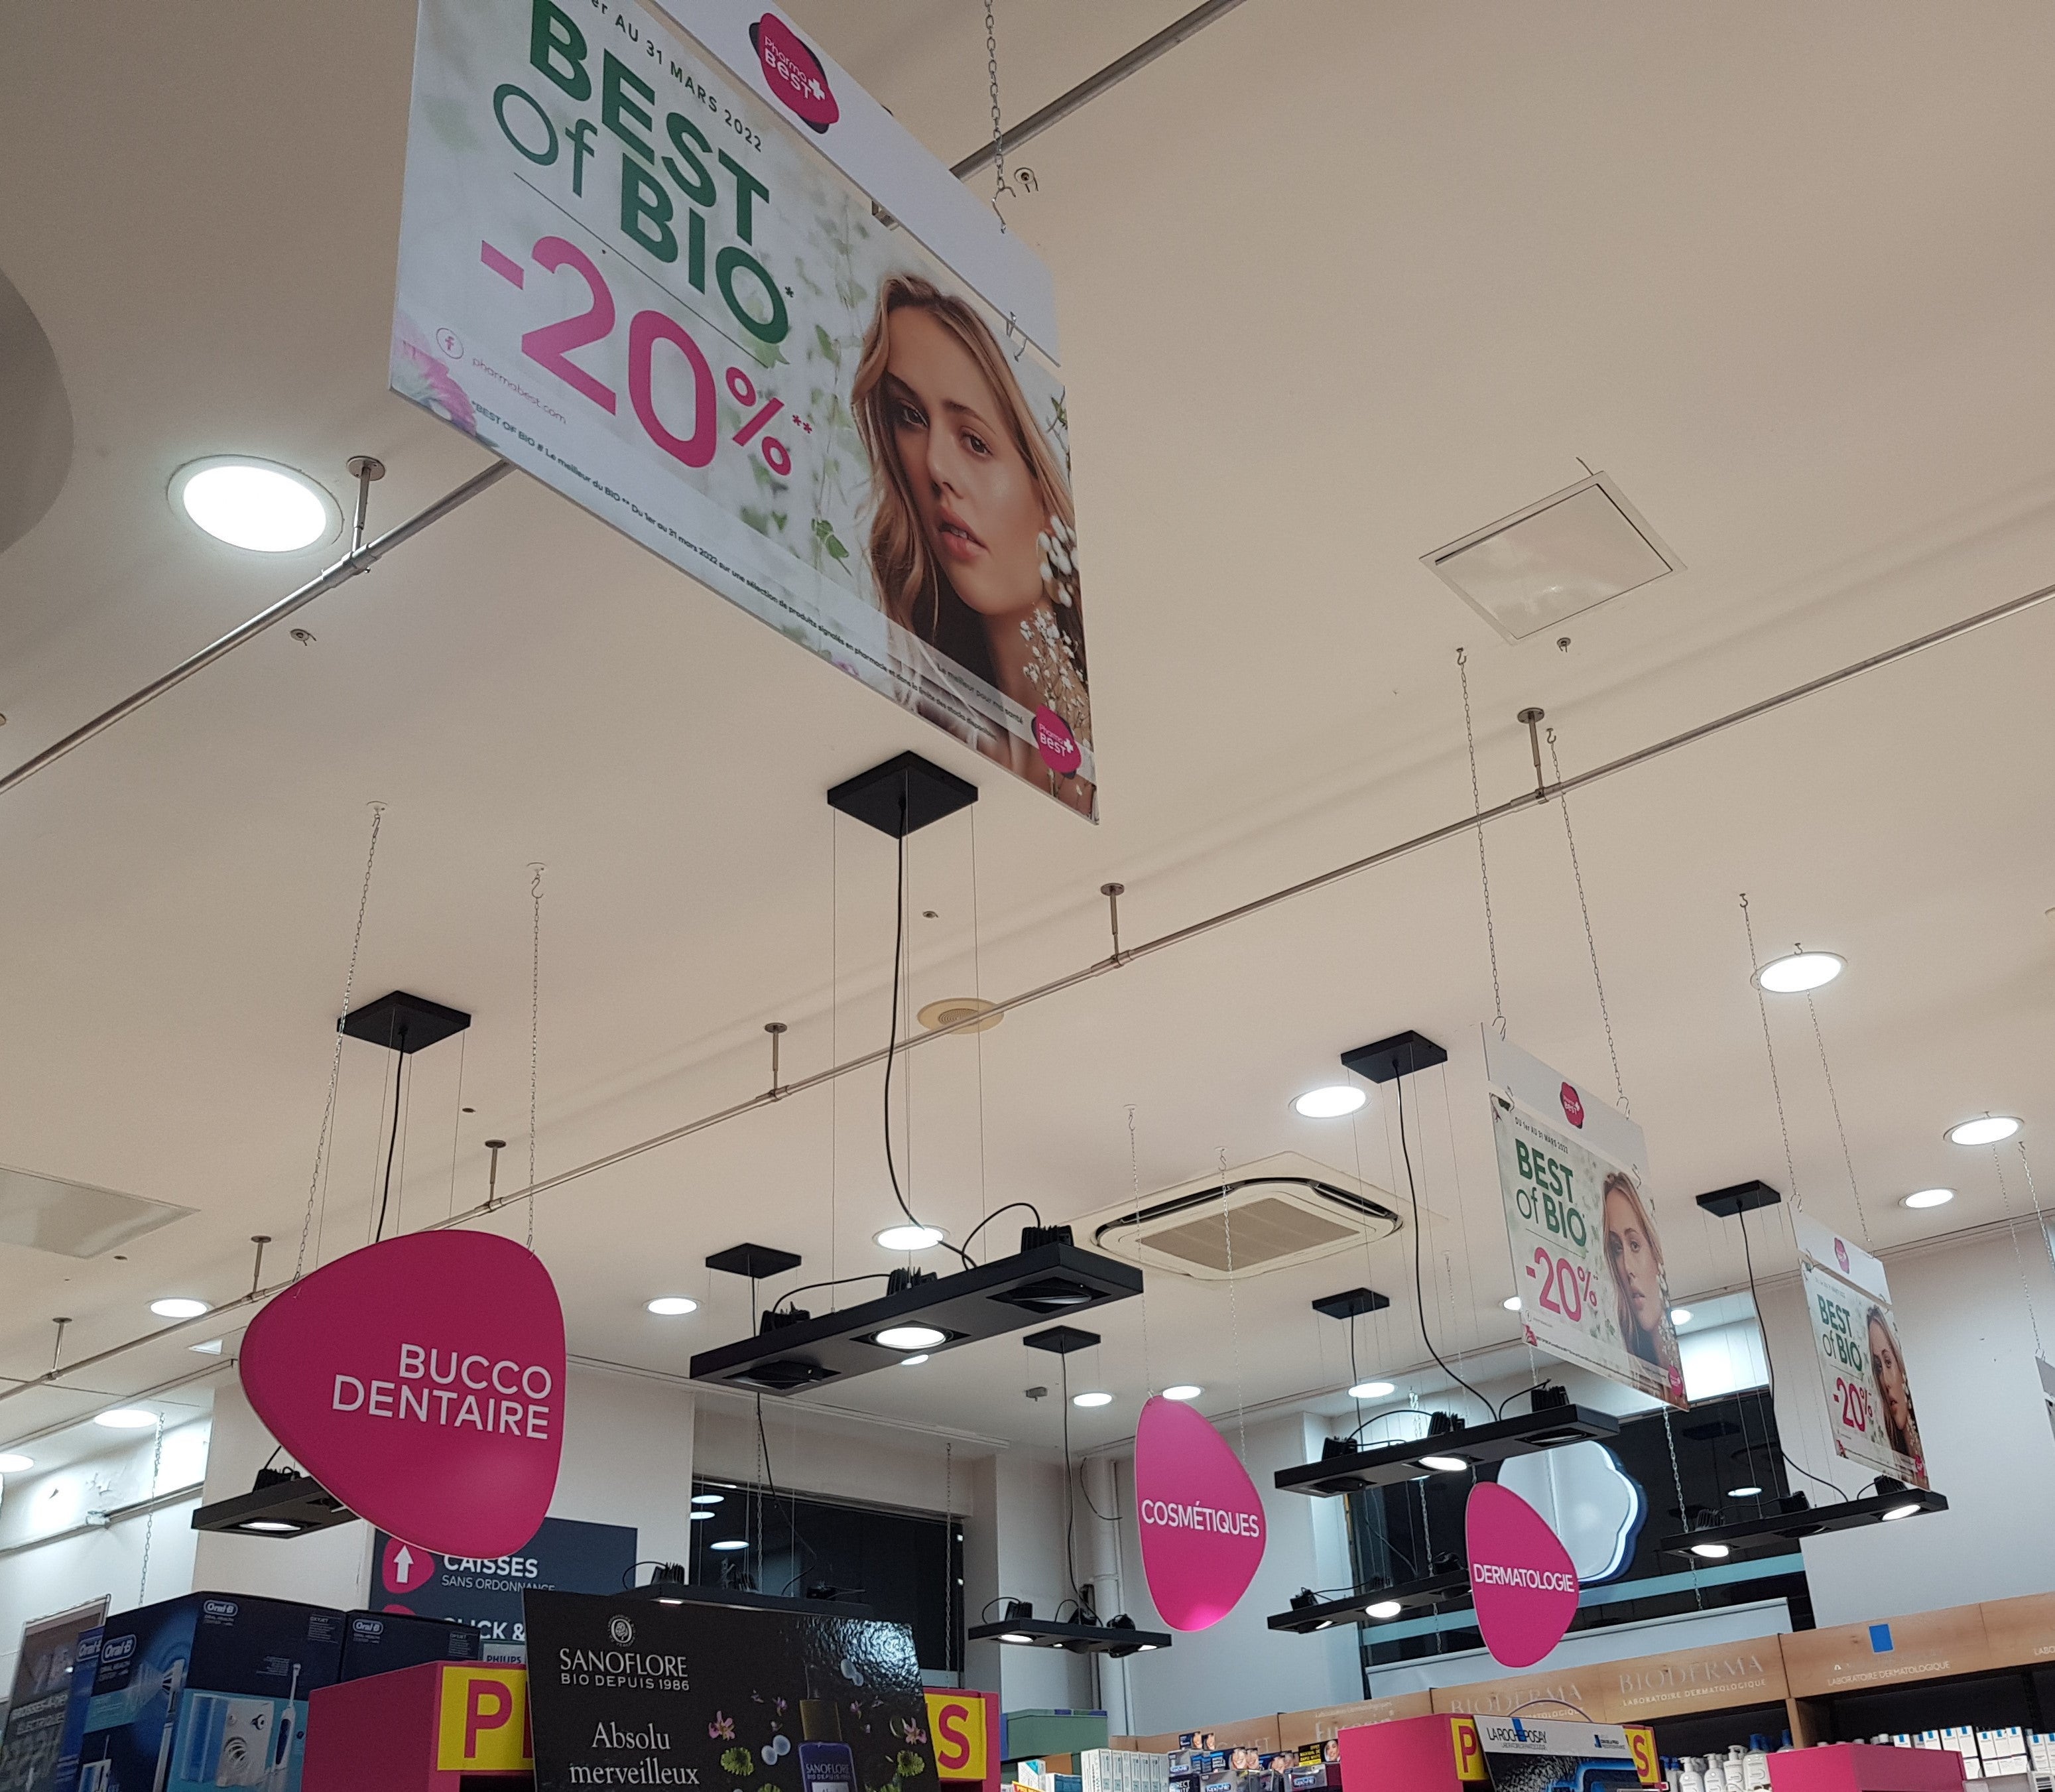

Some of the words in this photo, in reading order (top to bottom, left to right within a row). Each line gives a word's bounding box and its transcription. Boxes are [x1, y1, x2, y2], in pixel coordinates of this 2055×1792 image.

[764, 36, 807, 82] Pharma
[615, 14, 639, 42] AU
[646, 40, 662, 65] 31
[670, 60, 717, 113] MARS
[724, 109, 762, 153] 2022
[493, 84, 597, 198] Of
[530, 0, 770, 245] BEST
[472, 357, 567, 424] pharmabest.com
[502, 420, 517, 433] OF
[518, 431, 535, 448] BIO
[545, 448, 556, 462] Le
[558, 458, 592, 483] meilleur
[593, 480, 603, 491] du
[605, 486, 621, 502] BIO
[631, 503, 643, 517] Du
[645, 512, 656, 525] 1er
[657, 523, 667, 533] au
[668, 528, 678, 539] 31
[678, 536, 698, 552] mars
[719, 562, 731, 574] sur
[731, 570, 745, 582] une
[779, 600, 788, 610] de
[788, 606, 818, 628] produits
[1038, 723, 1065, 744] Pharma
[1515, 1138, 1574, 1204] BEST
[1516, 1186, 1539, 1224] Of
[1817, 1293, 1853, 1338] BEST
[398, 1343, 553, 1400] BUCCO
[332, 1374, 551, 1440] DENTAIRE
[1141, 1498, 1261, 1538] COSMÉTIQUES
[441, 1574, 473, 1589] SANS
[443, 1555, 538, 1578] CAISSES
[1473, 1563, 1576, 1594] DERMATOLOGIE
[559, 1647, 689, 1678] SANOFLORE
[560, 1673, 590, 1686] BIO
[595, 1675, 655, 1690] DEPUIS
[658, 1679, 690, 1691] 1986
[1619, 1655, 1764, 1694] BIODERMA
[1828, 1669, 1878, 1687] LABORATOIRE
[1879, 1660, 1951, 1679] DERMATOLOGIQUE
[1623, 1691, 1682, 1707] LABORATOIRE
[1684, 1678, 1767, 1698] DERMATOLOGIQUE
[592, 1721, 671, 1750] Absolu
[569, 1756, 700, 1785] merveilleux
